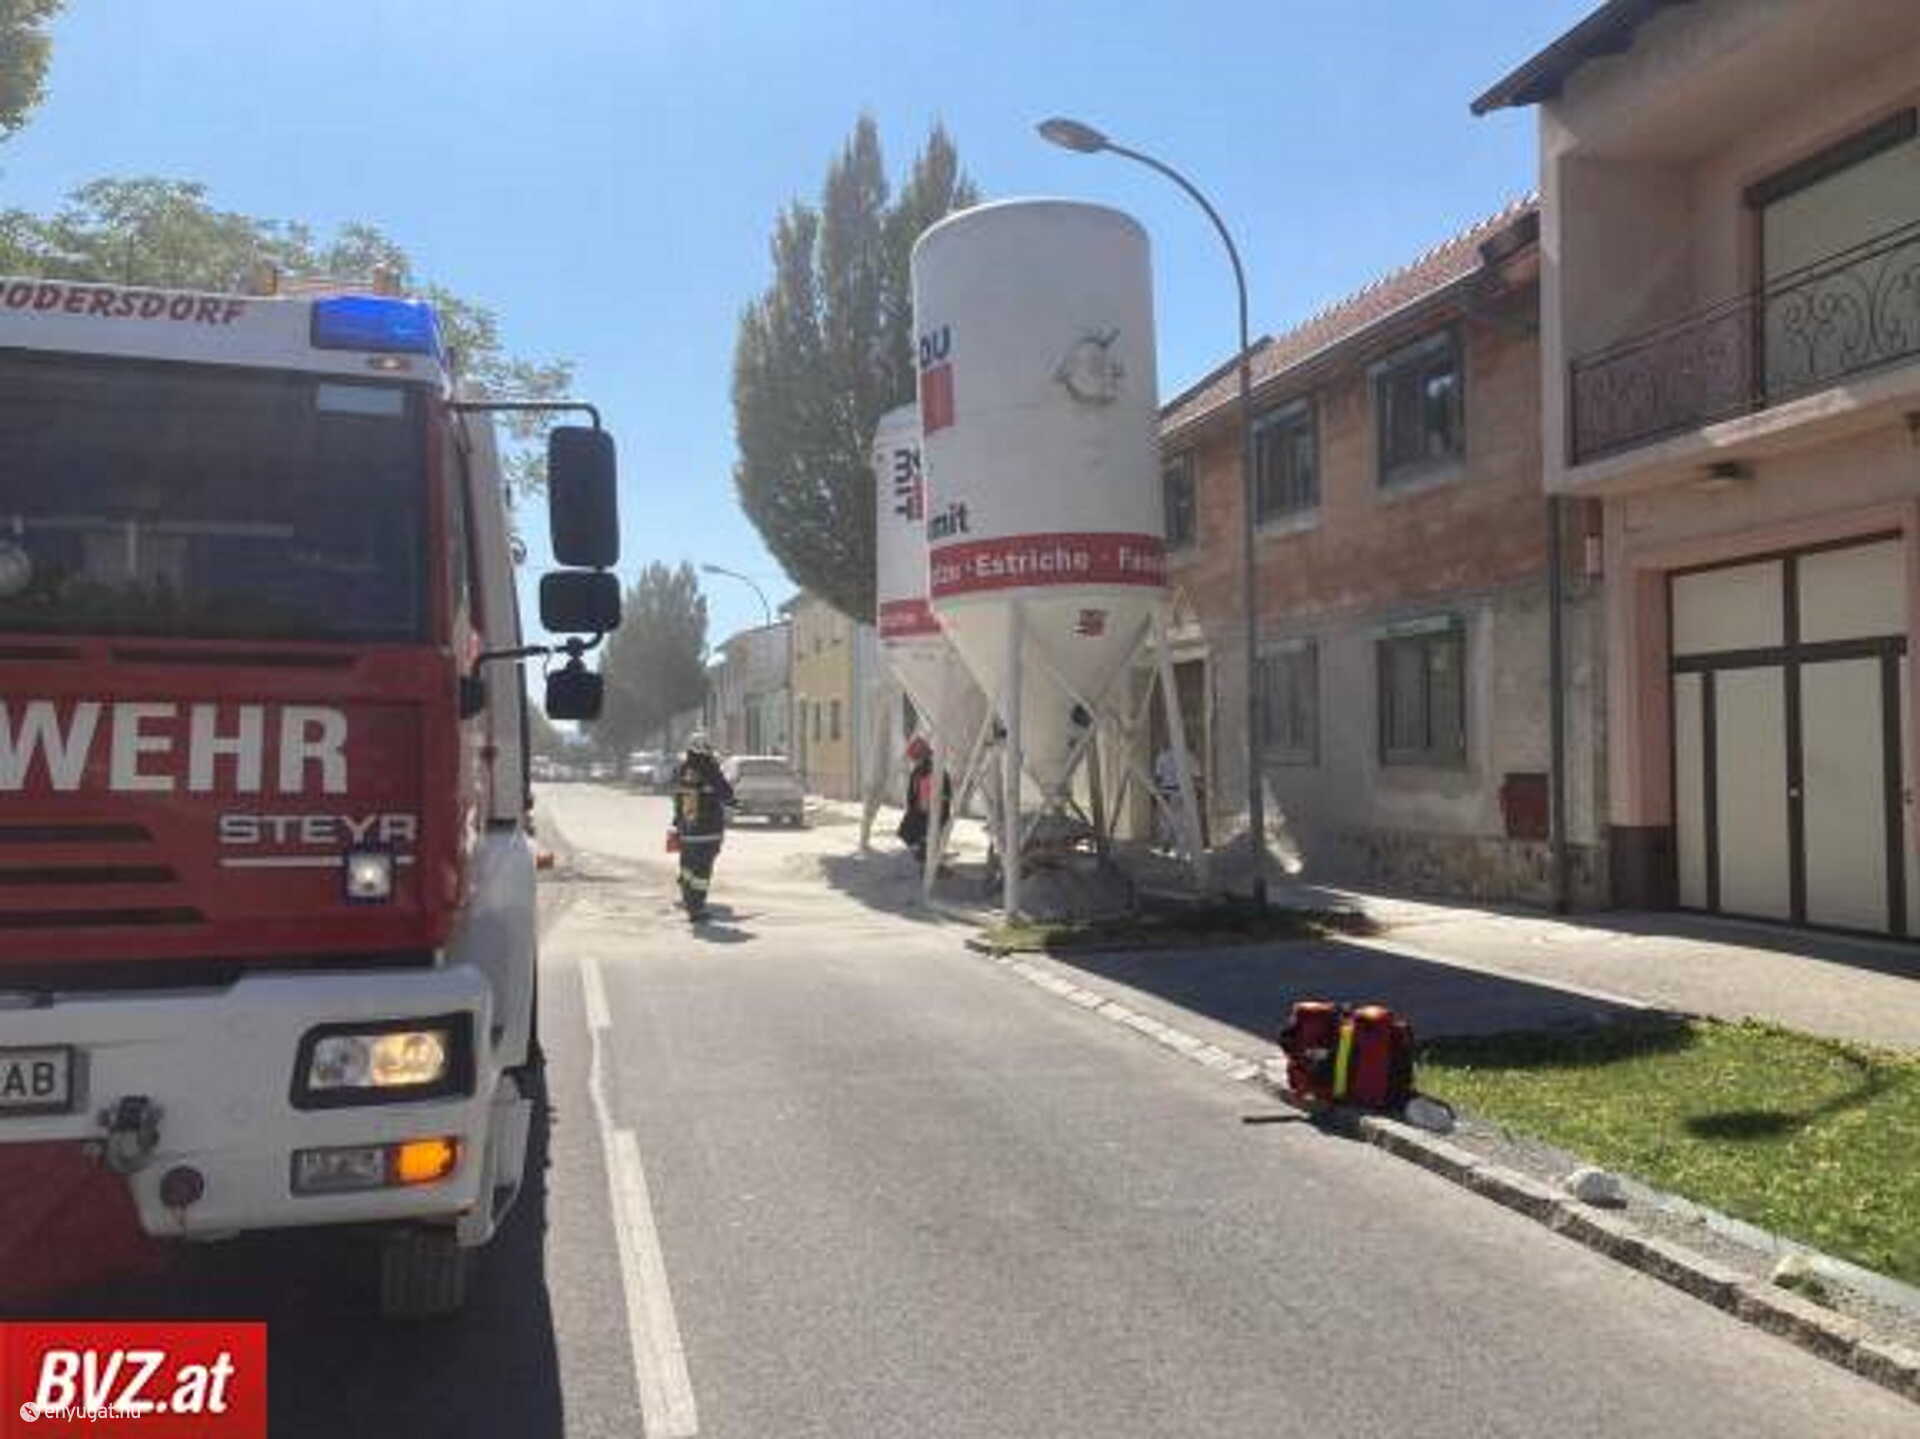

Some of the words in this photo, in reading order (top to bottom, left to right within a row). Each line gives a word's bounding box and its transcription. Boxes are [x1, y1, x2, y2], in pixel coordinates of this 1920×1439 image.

[0, 281, 248, 325] ODERSDORF
[976, 543, 1090, 578] Estriche
[0, 699, 350, 794] WEHR
[219, 813, 418, 845] STEYR
[2, 1062, 54, 1097] AB
